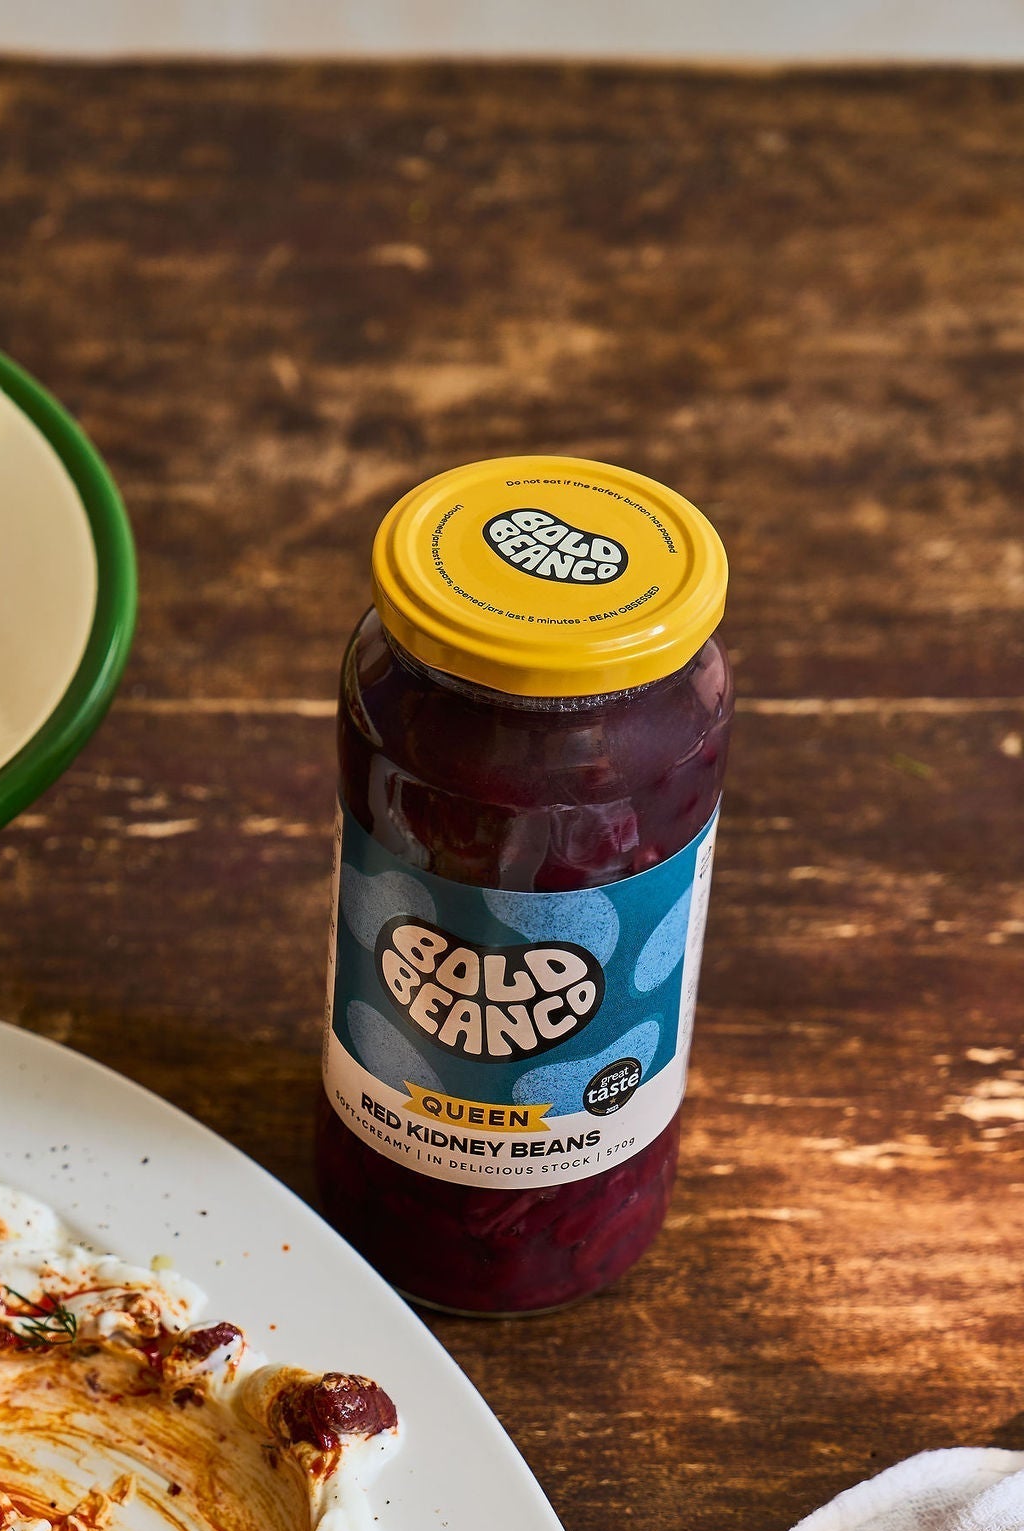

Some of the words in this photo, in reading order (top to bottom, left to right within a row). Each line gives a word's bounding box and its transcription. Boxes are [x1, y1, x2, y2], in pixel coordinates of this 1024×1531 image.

[435, 504, 465, 535] Unopened
[573, 481, 591, 489] the
[592, 486, 623, 500] safety
[623, 497, 651, 517] button
[649, 514, 663, 529] has
[658, 528, 678, 554] popped
[431, 533, 443, 548] jars
[511, 511, 622, 563] BOLD
[431, 547, 441, 561] last
[453, 585, 487, 608] opened
[482, 603, 504, 615] jars
[618, 585, 661, 614] OBSESSED
[505, 611, 526, 621] last
[536, 616, 581, 625] minutes
[588, 609, 618, 623] BEAN
[391, 923, 587, 1002] BOLD
[600, 1066, 630, 1088] great
[422, 1095, 529, 1127] QUEEN
[361, 1092, 402, 1130] RED
[407, 1121, 505, 1158] KIDNEY
[511, 1130, 601, 1159] BEANS
[427, 1153, 442, 1165] IN
[449, 1160, 534, 1175] DELICIOUS
[541, 1156, 590, 1173] STOCK
[606, 1137, 636, 1156] 570g
